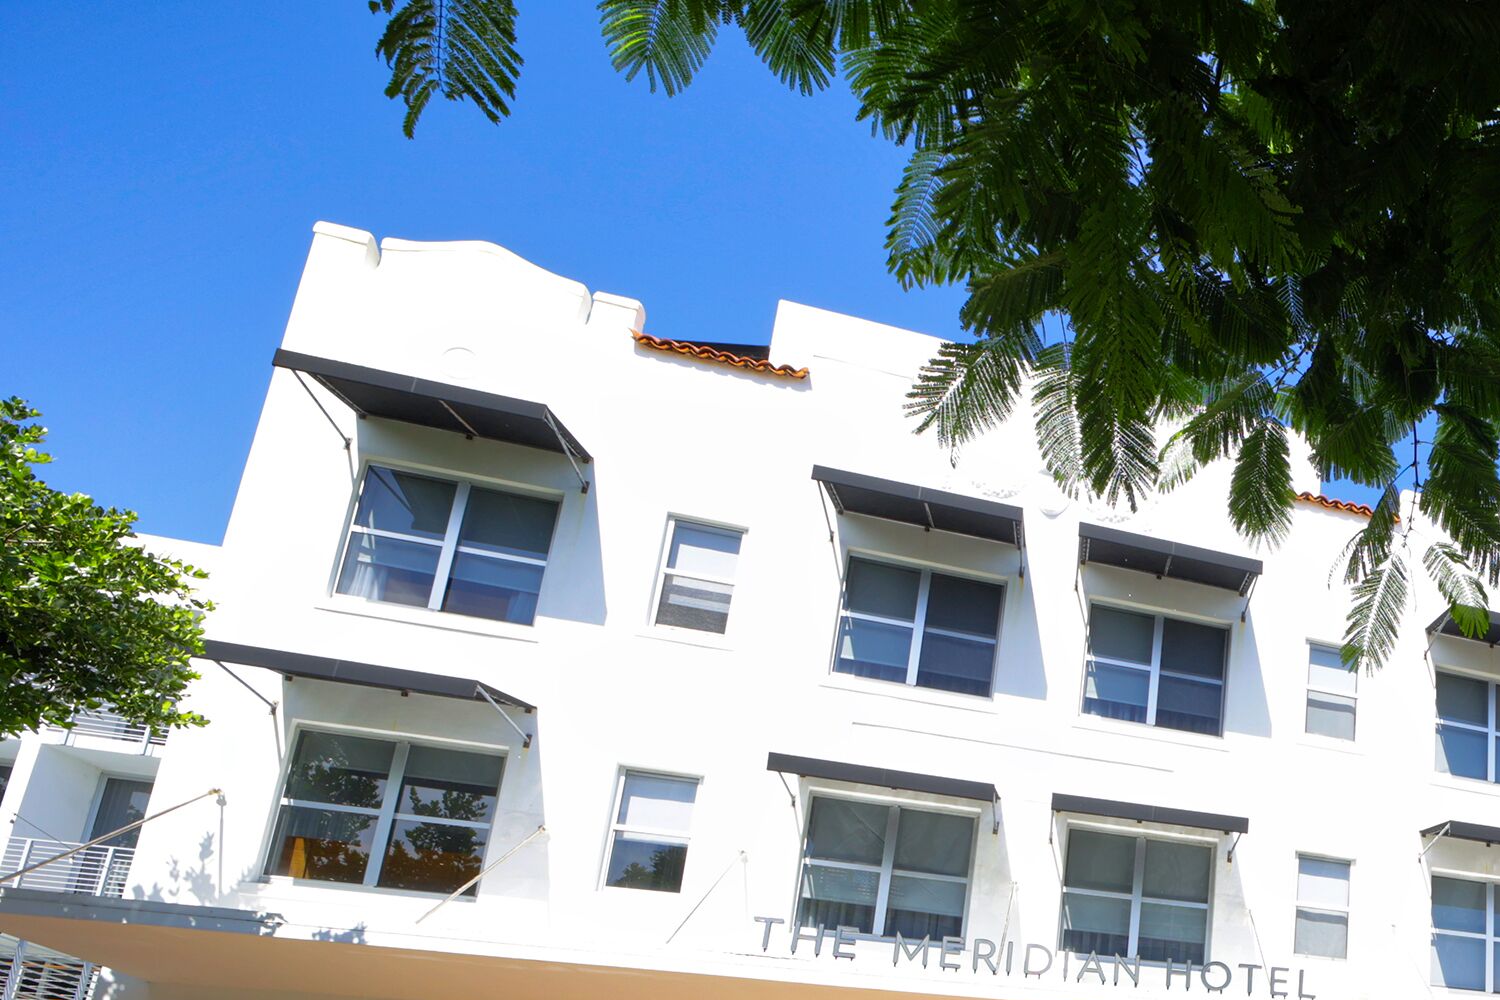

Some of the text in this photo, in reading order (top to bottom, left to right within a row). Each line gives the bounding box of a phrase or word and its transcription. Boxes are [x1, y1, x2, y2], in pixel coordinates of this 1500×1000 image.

[754, 916, 1316, 1000] THE MERIDIAN HOTEL
